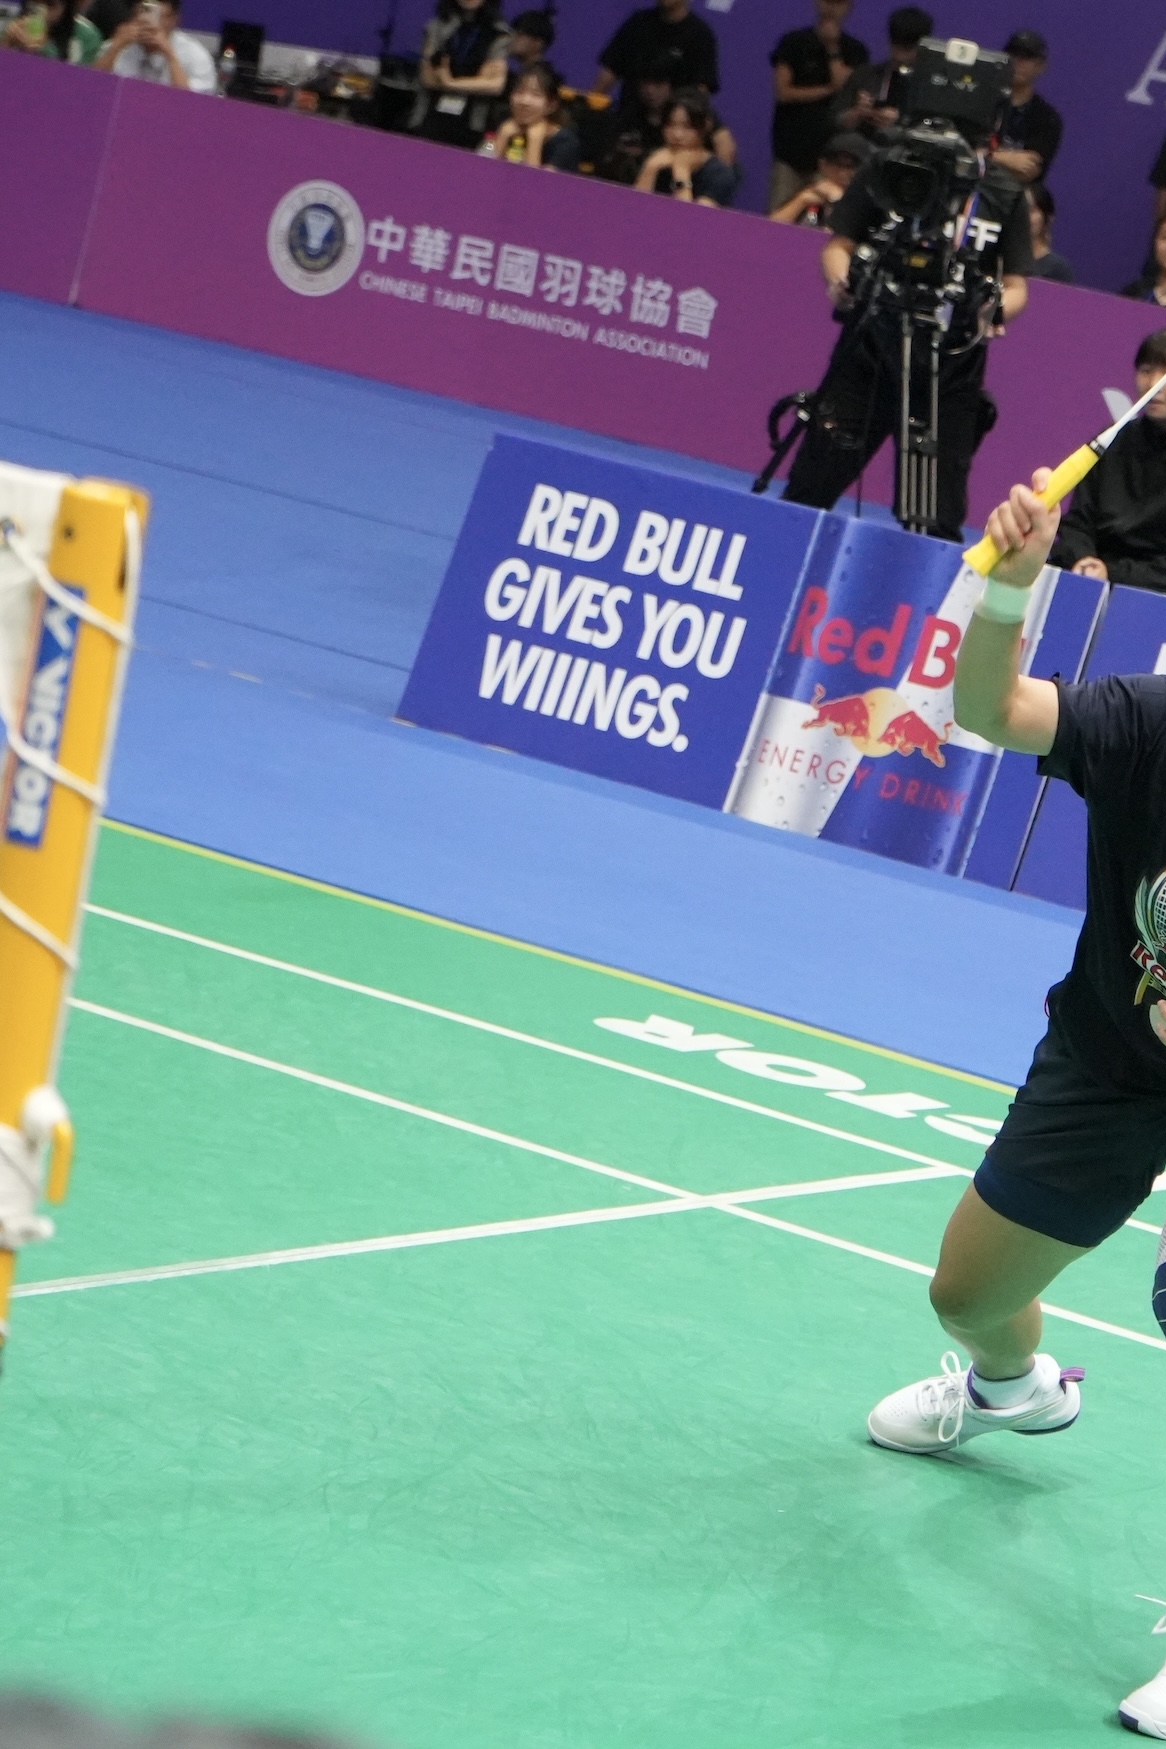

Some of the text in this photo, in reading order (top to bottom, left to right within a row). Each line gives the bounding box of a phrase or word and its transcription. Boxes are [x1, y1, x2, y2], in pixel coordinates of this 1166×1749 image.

[358, 270, 709, 369] CHINESE TAIPEI BADMINTON ASSOCIATION
[366, 215, 718, 338] 中華民國羽球協會
[517, 483, 747, 601] RED BULL
[484, 558, 747, 679] GIVES YOU
[788, 586, 913, 677] Red
[9, 657, 69, 838] VICOR
[479, 633, 689, 752] WIIINGS.
[758, 739, 969, 815] ENERGY DRINK
